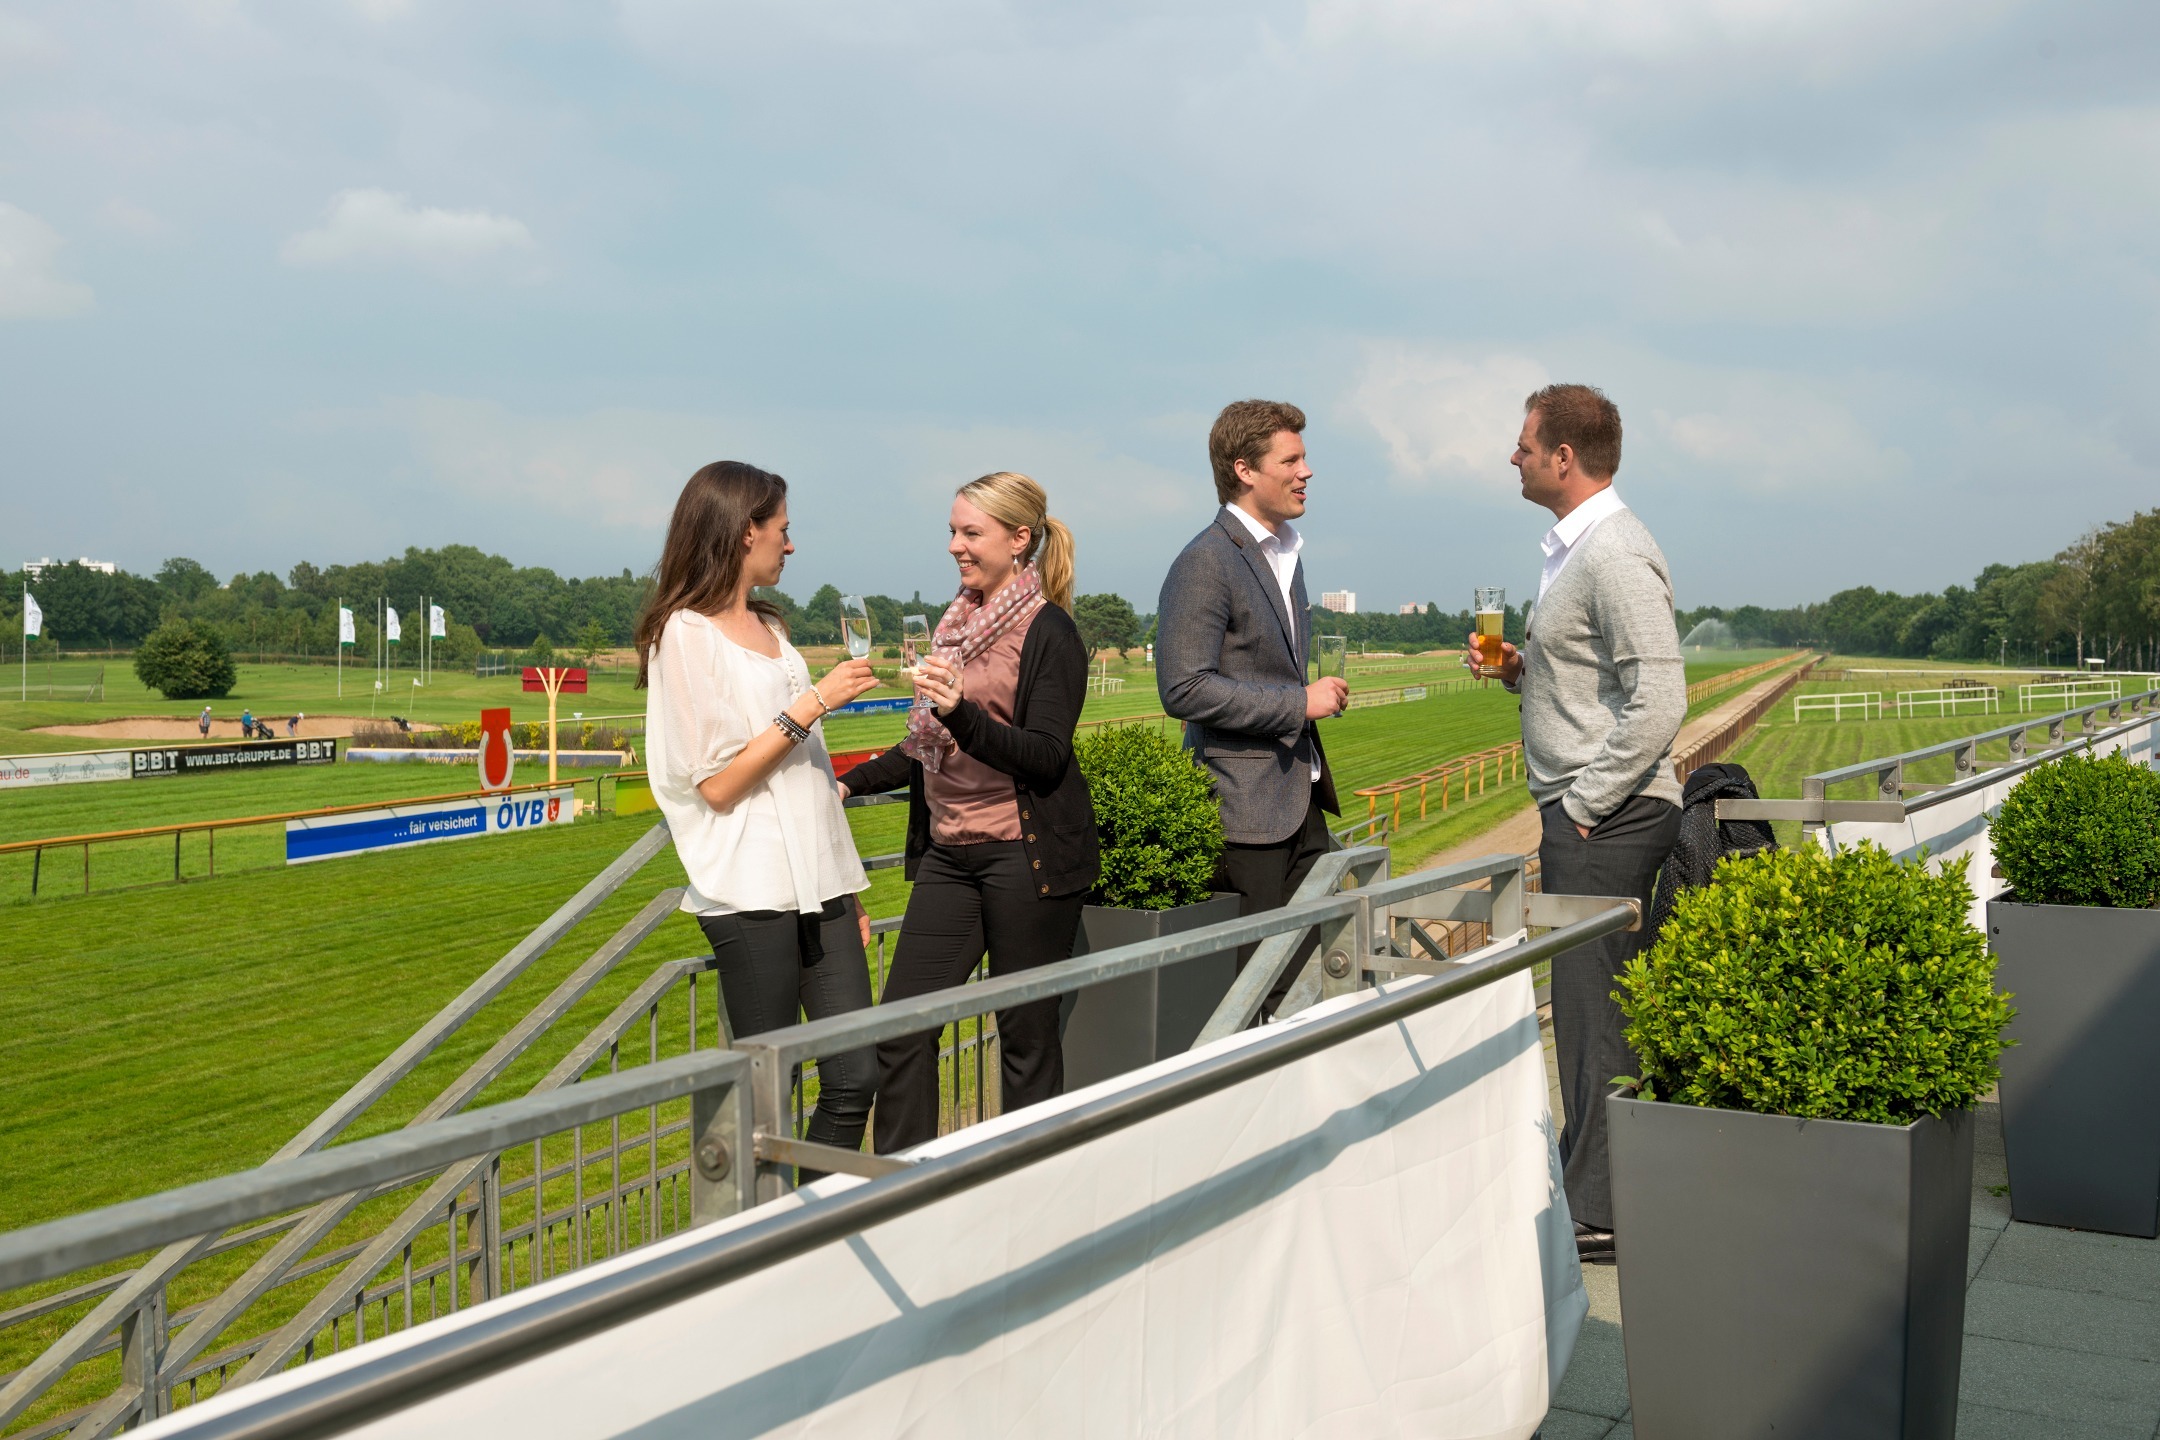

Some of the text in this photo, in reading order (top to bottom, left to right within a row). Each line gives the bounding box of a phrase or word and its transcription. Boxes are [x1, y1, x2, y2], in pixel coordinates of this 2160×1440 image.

[185, 749, 291, 767] WWW.BBT-GRUPPE.DE
[296, 741, 334, 759] BBT
[134, 751, 179, 770] BBT
[498, 797, 545, 829] ÖVB
[428, 814, 477, 832] versichert
